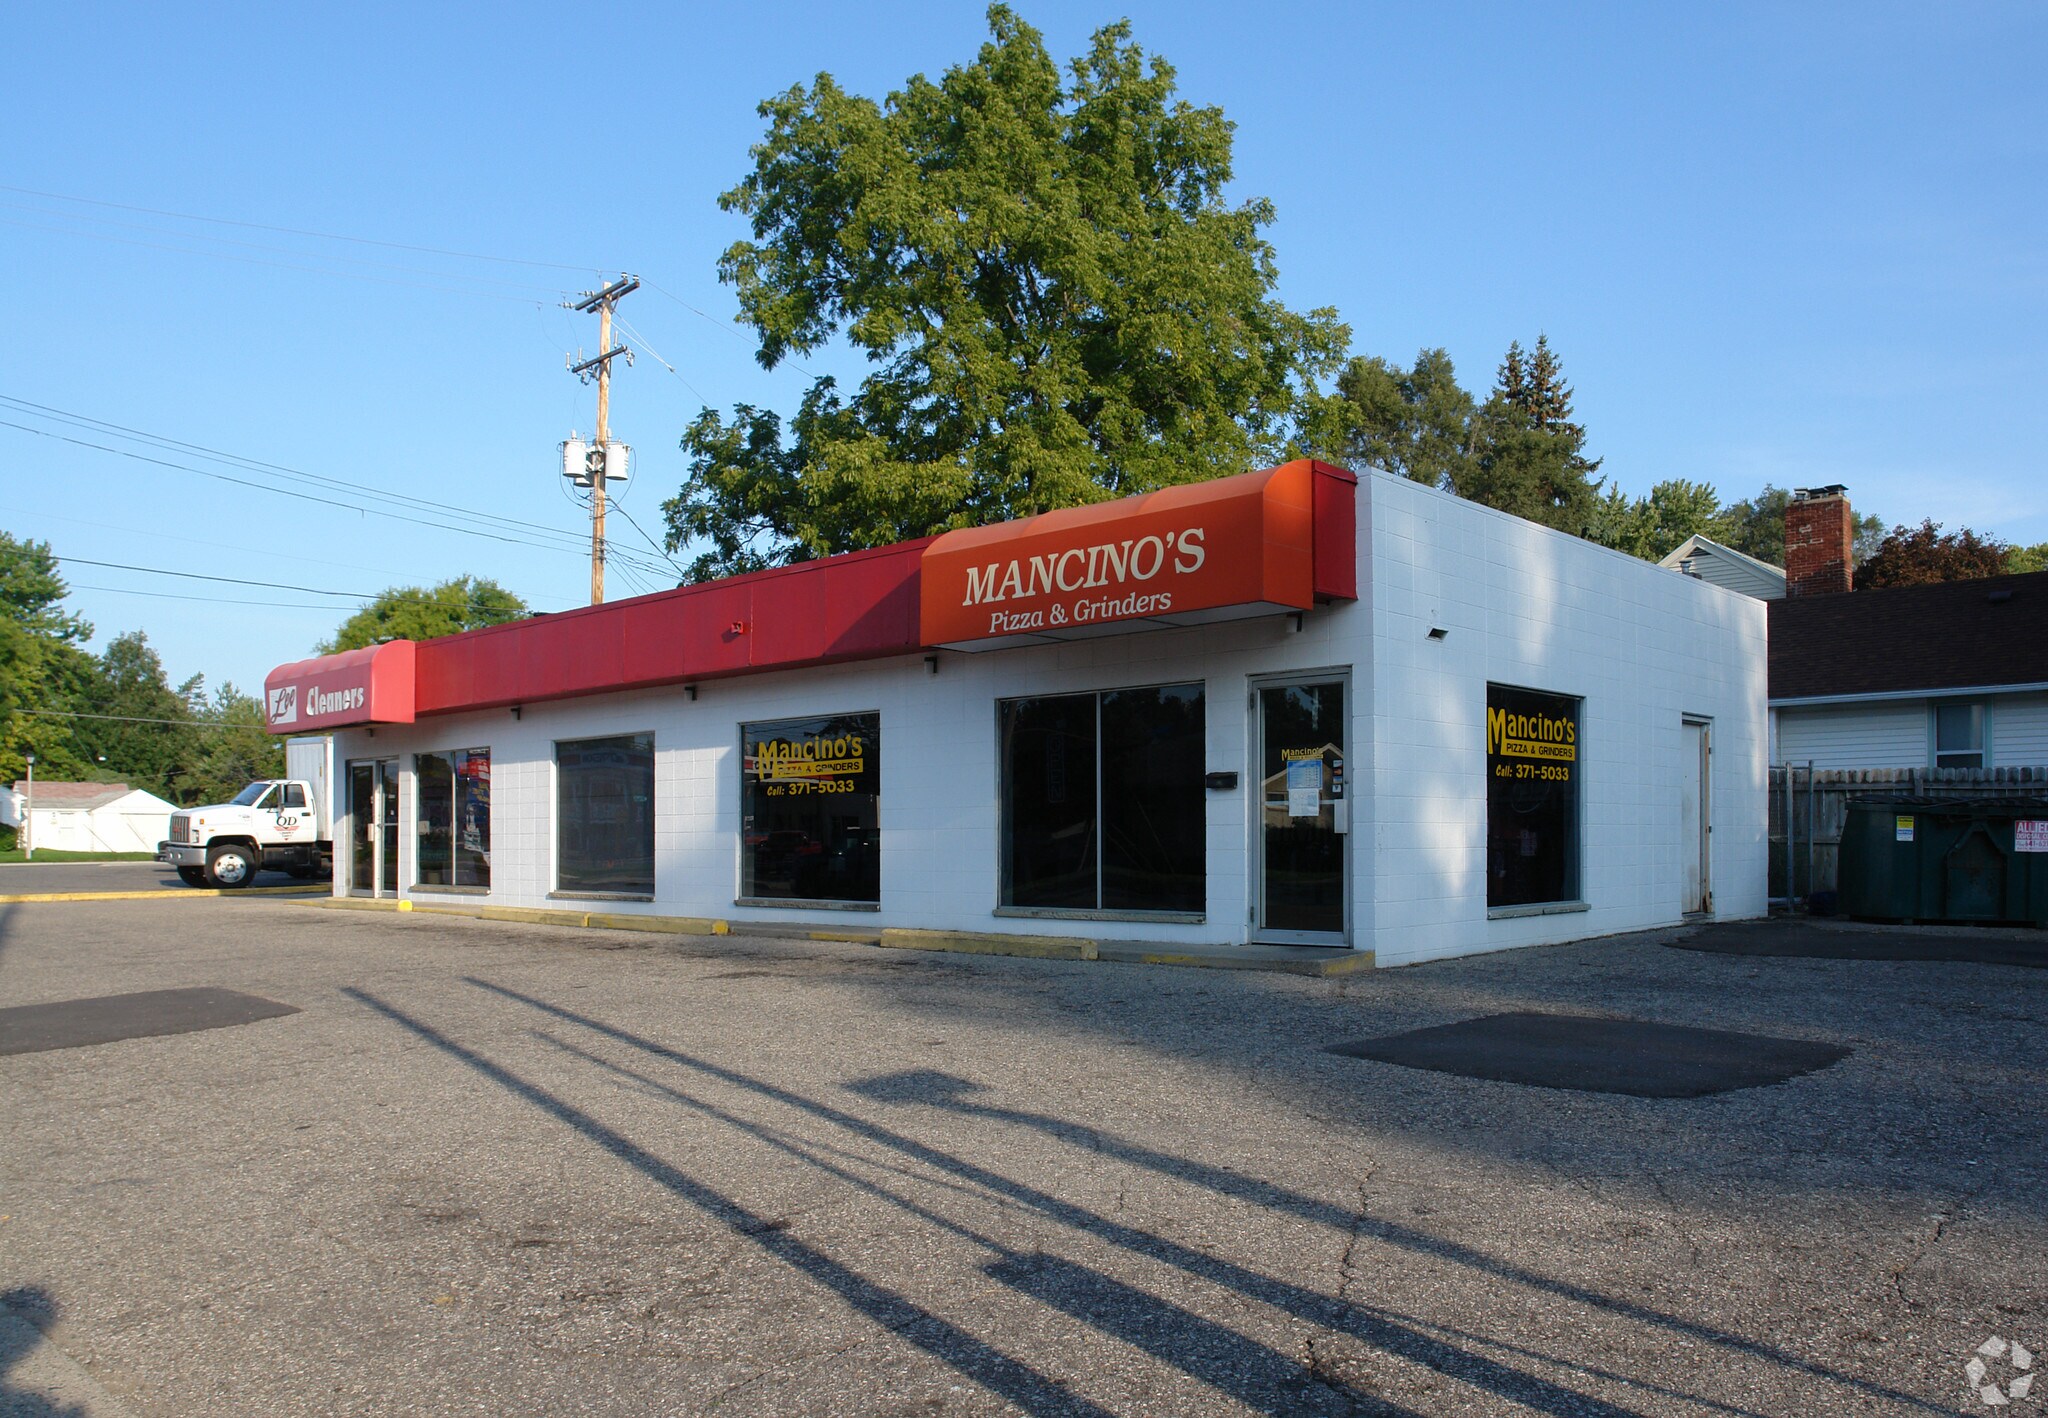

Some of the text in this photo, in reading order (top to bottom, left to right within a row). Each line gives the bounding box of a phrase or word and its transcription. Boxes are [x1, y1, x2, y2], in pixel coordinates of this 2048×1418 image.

[962, 527, 1206, 607] MANCINO'S
[988, 592, 1172, 634] Pizza & Grinders
[306, 686, 365, 716] Cleaners
[1487, 706, 1575, 755] Mancino's
[758, 733, 863, 780] Mancino's
[1506, 743, 1573, 758] PIZZA & GRINDERS
[1495, 763, 1569, 781] Call: 371-5033
[767, 779, 855, 796] Call: 371-5033
[276, 815, 298, 827] QD
